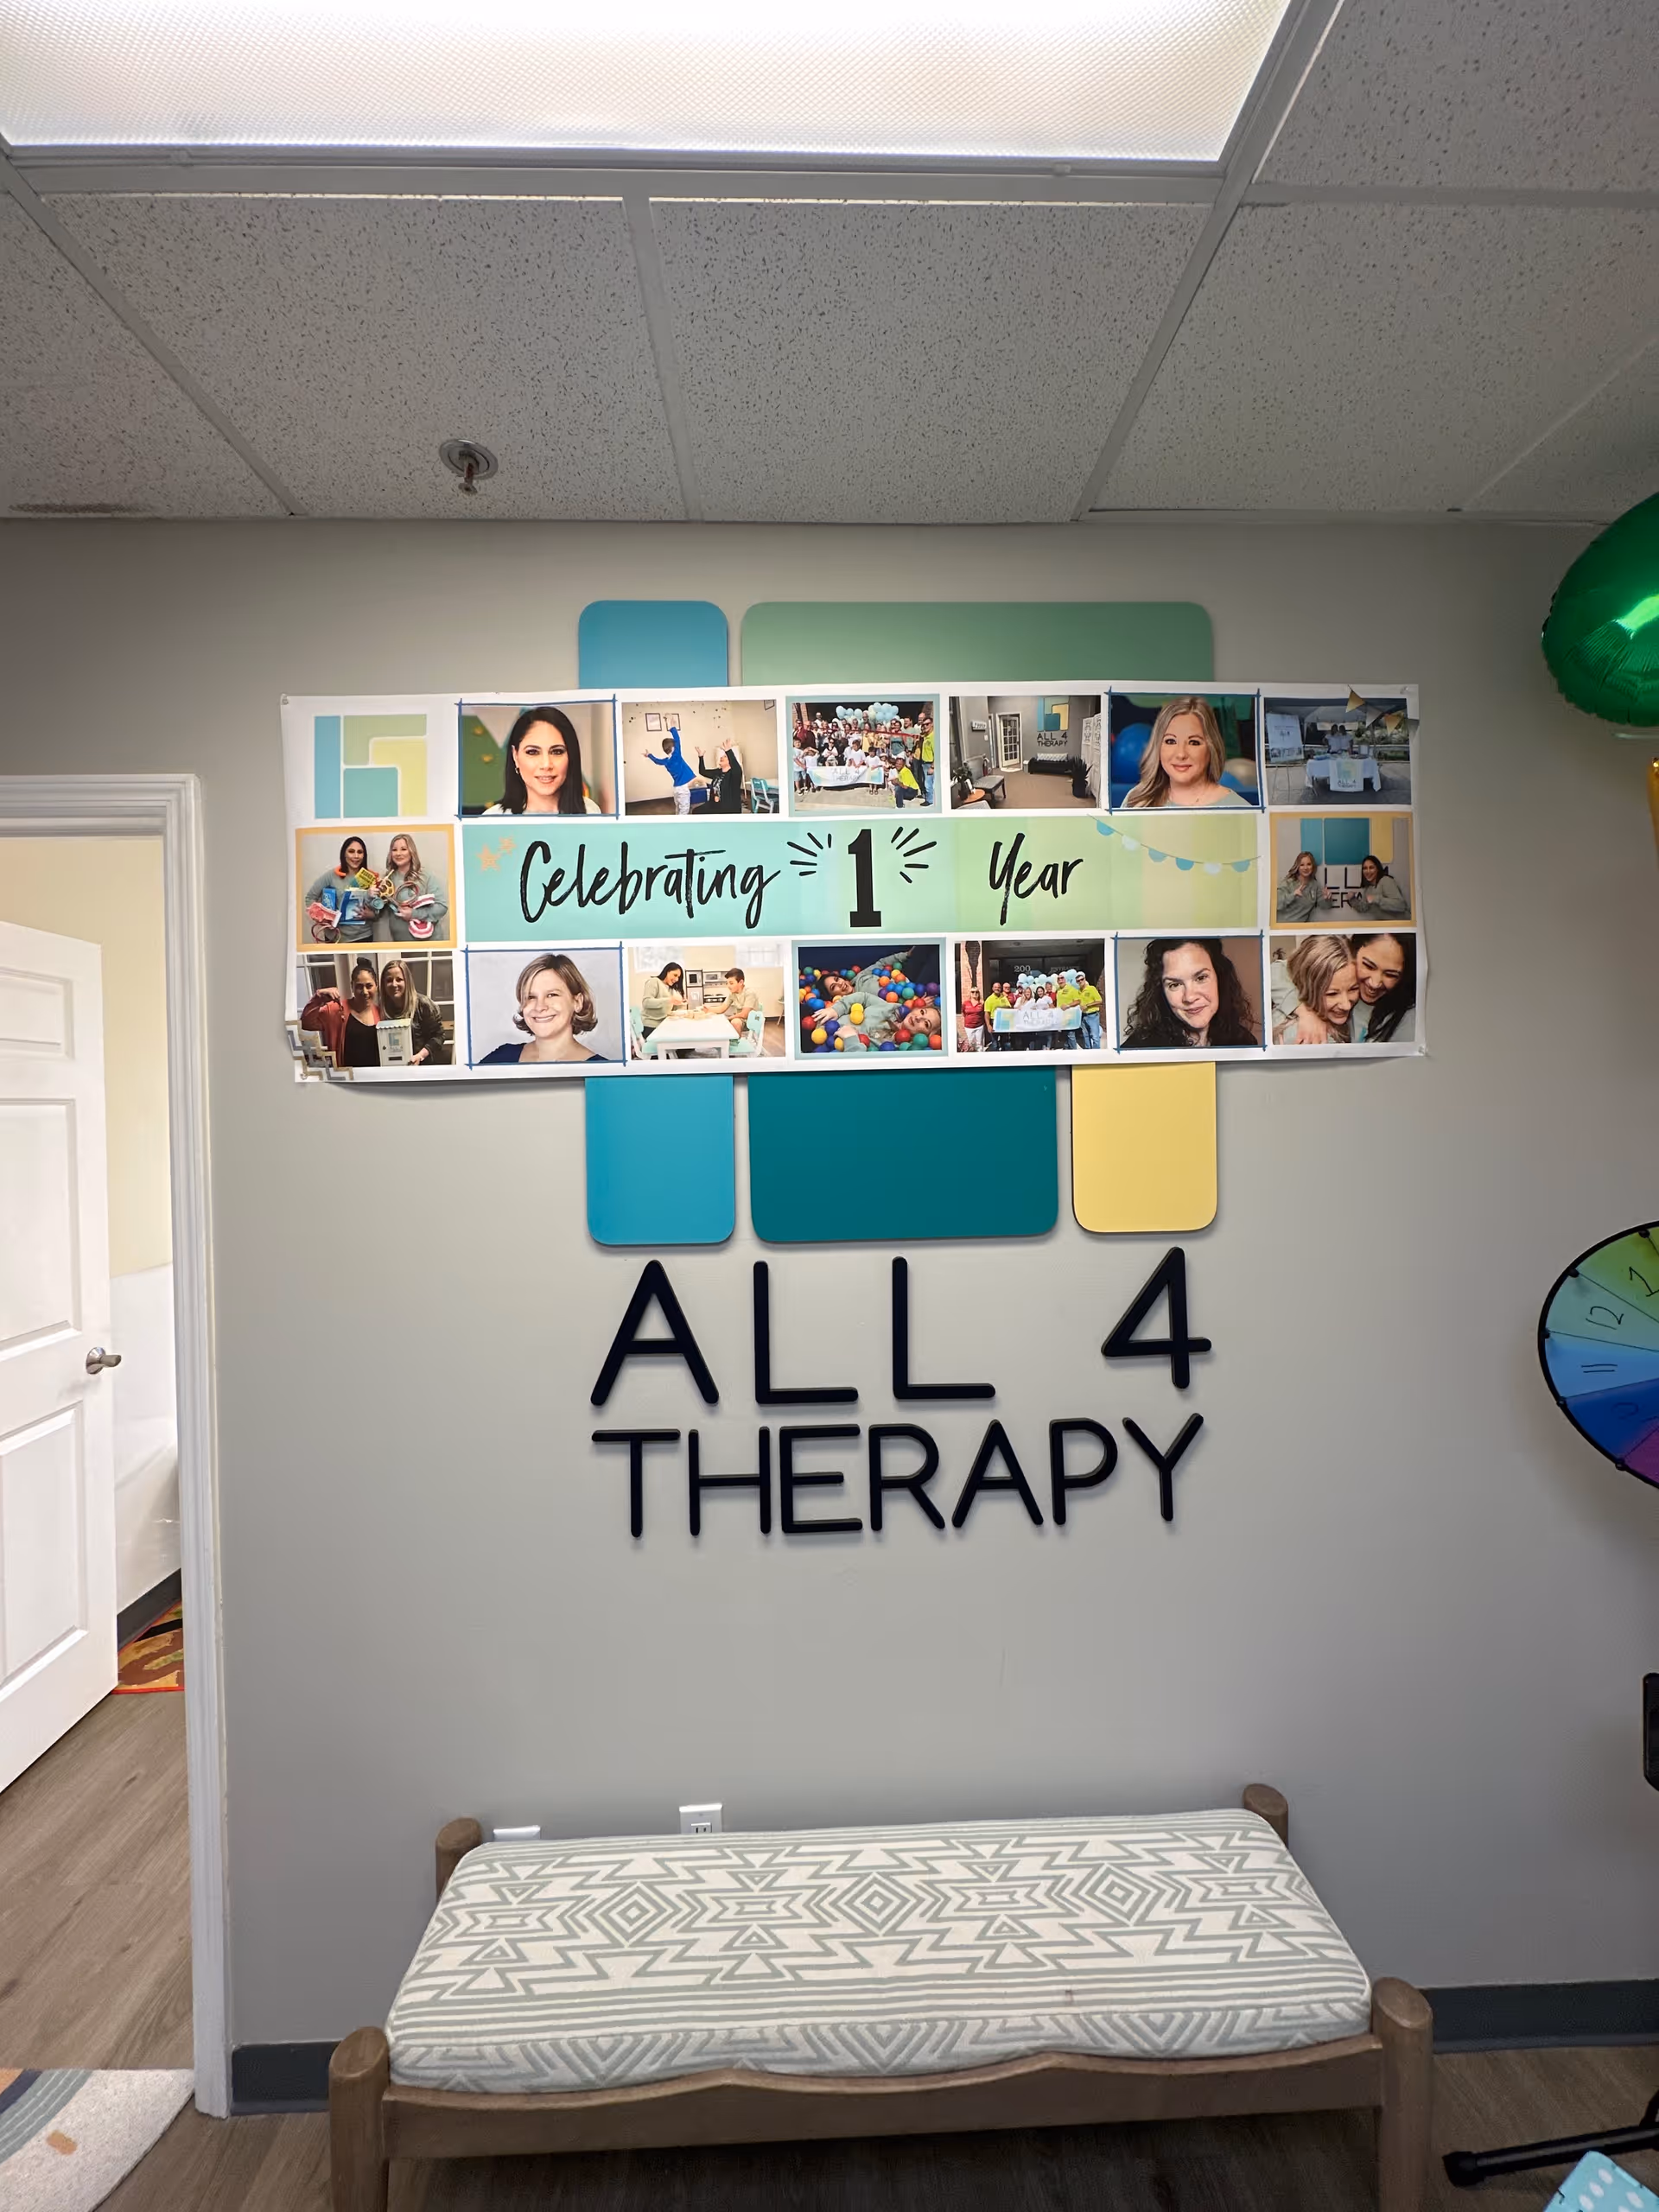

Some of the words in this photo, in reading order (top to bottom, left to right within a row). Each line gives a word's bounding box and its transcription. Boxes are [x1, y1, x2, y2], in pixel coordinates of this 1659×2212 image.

[520, 840, 781, 929] Celebrating
[848, 829, 881, 927] 1
[989, 832, 1084, 925] Year
[1023, 1010, 1042, 1020] ALL
[590, 1256, 995, 1405] ALL
[1101, 1247, 1212, 1389] 4
[591, 1414, 1204, 1538] THERAPY
